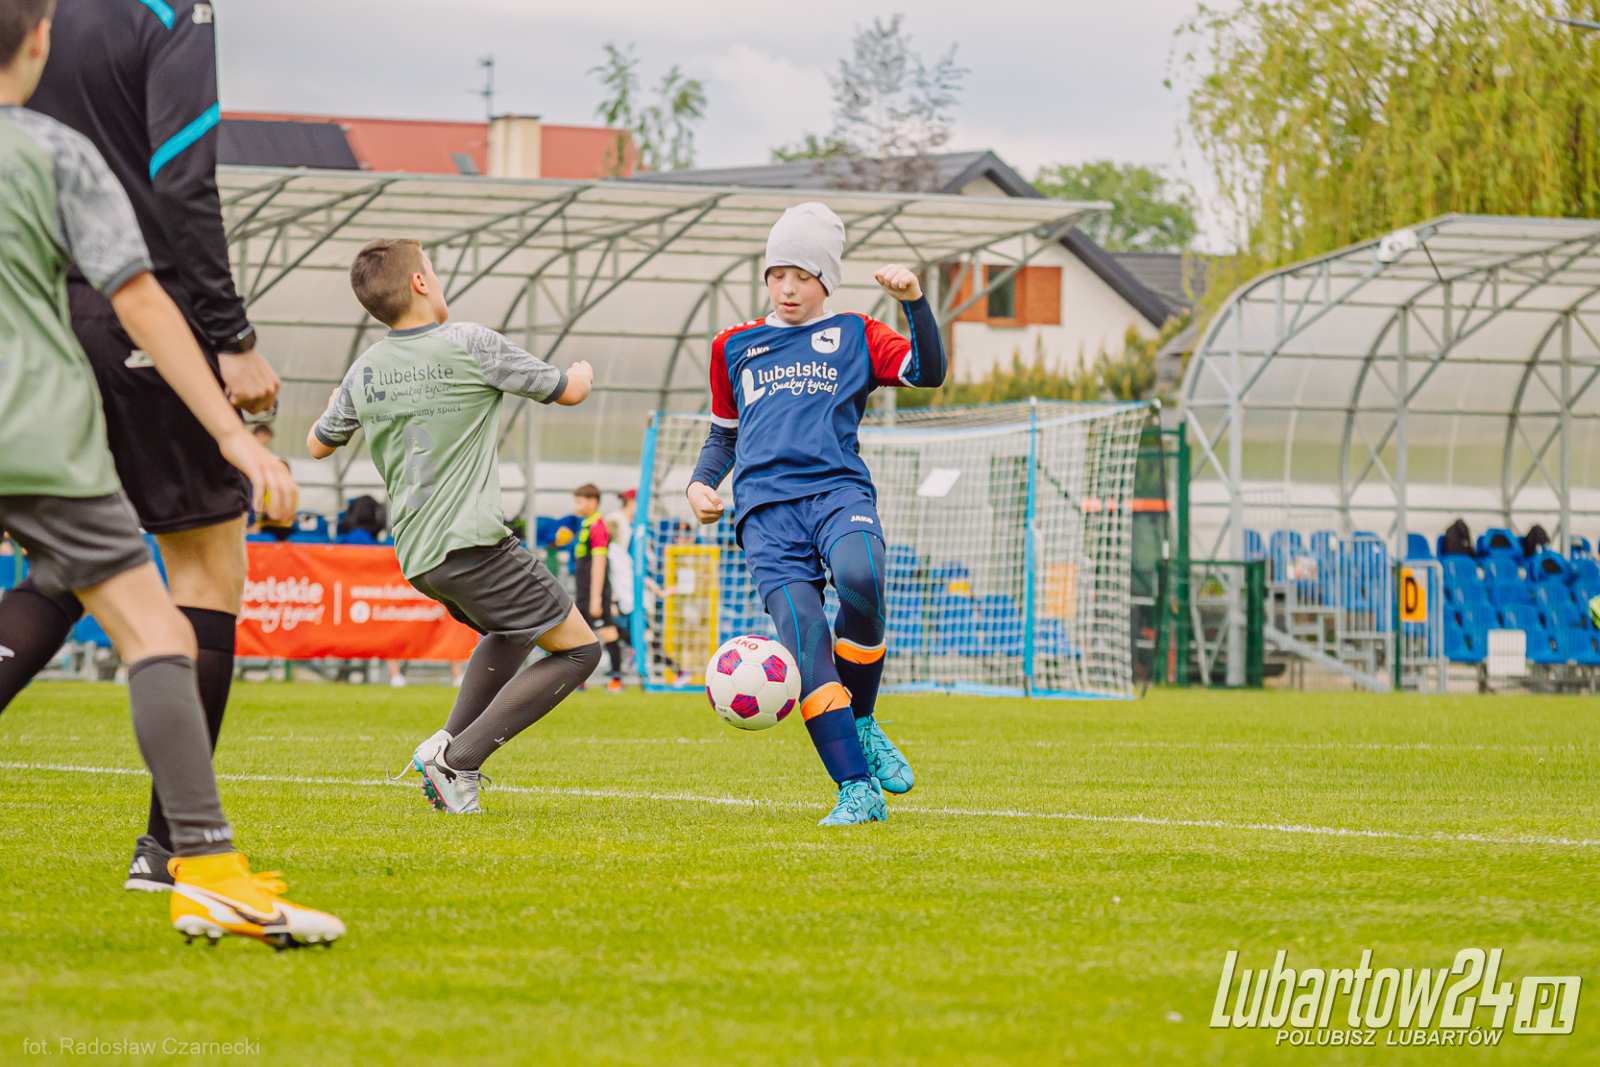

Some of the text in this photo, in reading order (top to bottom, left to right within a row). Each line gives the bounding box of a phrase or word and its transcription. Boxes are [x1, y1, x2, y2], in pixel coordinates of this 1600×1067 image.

[746, 346, 770, 358] JAKO
[378, 363, 454, 386] lubelskie
[758, 361, 838, 385] lubelskie
[768, 378, 807, 396] Smakuj
[1405, 577, 1418, 614] D
